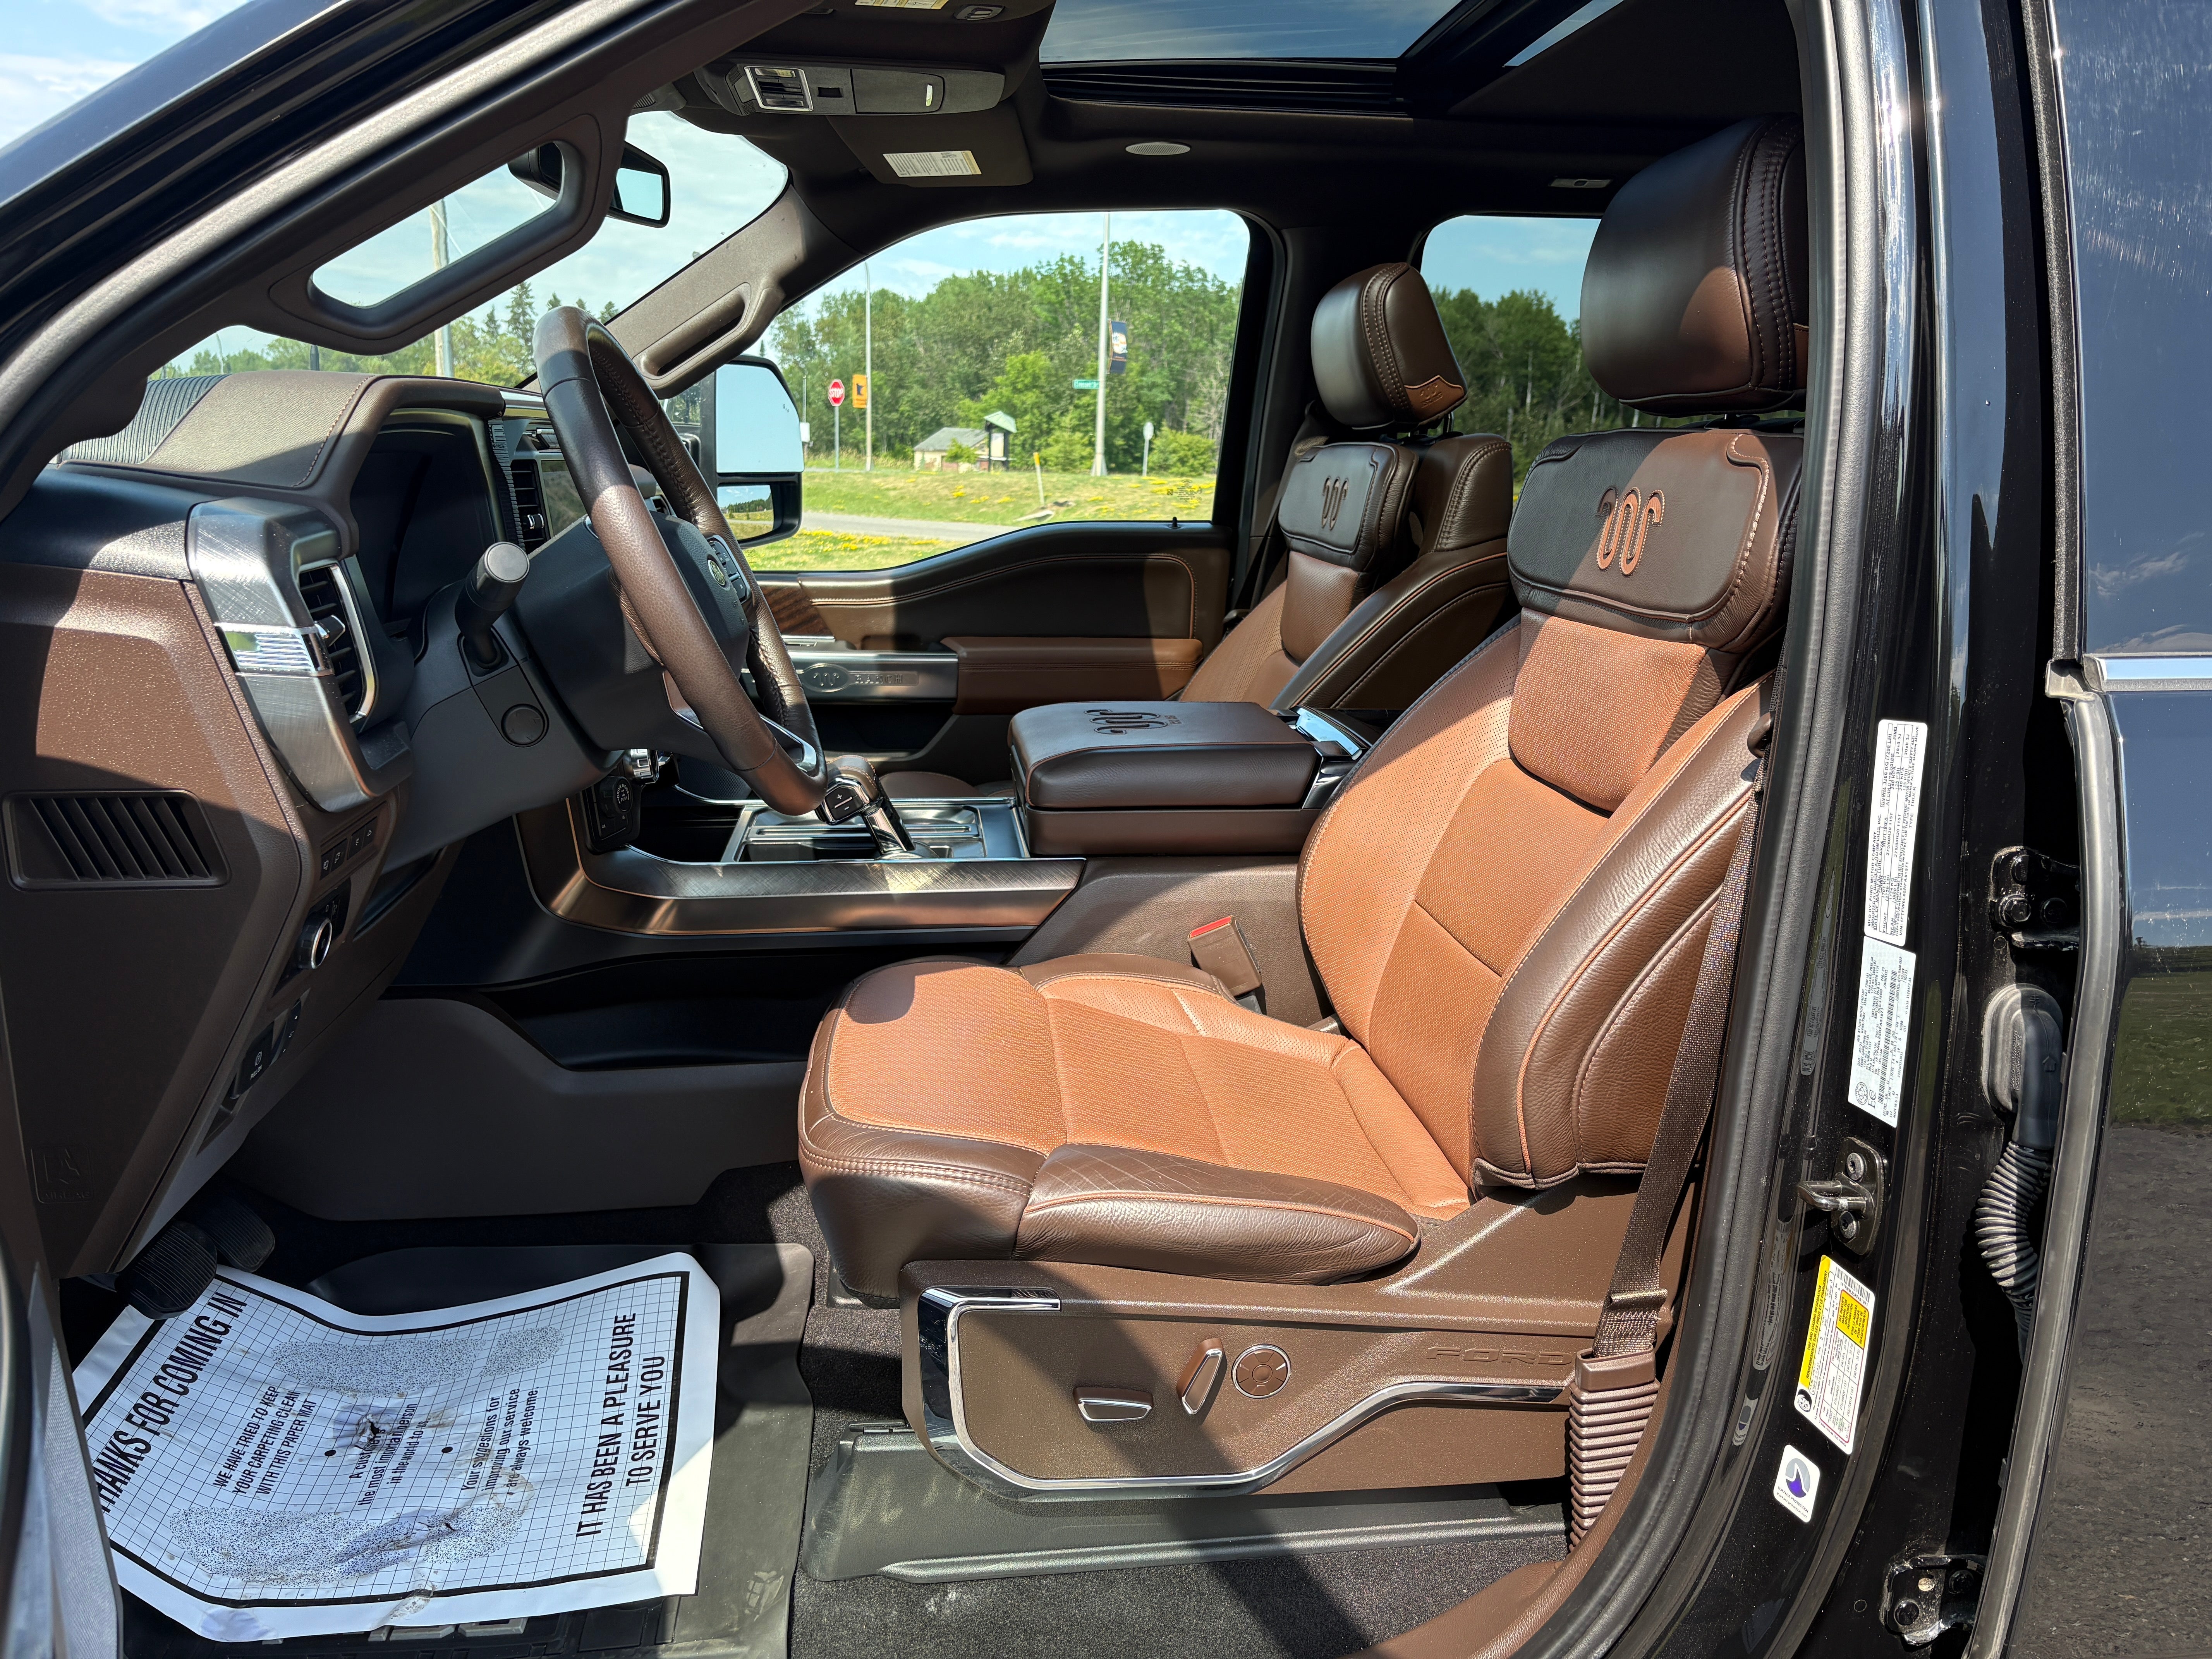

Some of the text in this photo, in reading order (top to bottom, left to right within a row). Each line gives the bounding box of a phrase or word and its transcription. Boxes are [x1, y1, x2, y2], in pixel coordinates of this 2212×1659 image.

[829, 388, 843, 398] STOP
[1820, 1269, 1828, 1298] CHARGEMENT
[1426, 1346, 1572, 1365] FORD
[93, 1292, 247, 1513] HANKS FOR COMING IN
[409, 1430, 424, 1439] to
[576, 1313, 636, 1537] IT HAS BEEN A PLEASURE
[626, 1356, 665, 1487] TO SERVE YOU
[213, 1386, 280, 1488] WE HAVE TRIED TO KEEP
[233, 1391, 301, 1495] YOUR CARPETING CLEAN
[256, 1398, 317, 1495] WITH THIS PAPER MAT
[392, 1462, 409, 1474] the
[401, 1441, 420, 1461] world
[461, 1397, 500, 1490] Your suggestions for
[481, 1389, 520, 1491] improving our service
[506, 1386, 539, 1487] are always welcome.
[358, 1491, 376, 1506] the
[368, 1465, 386, 1488] most
[387, 1476, 403, 1484] in
[1790, 1496, 1808, 1513] PROTECTION
